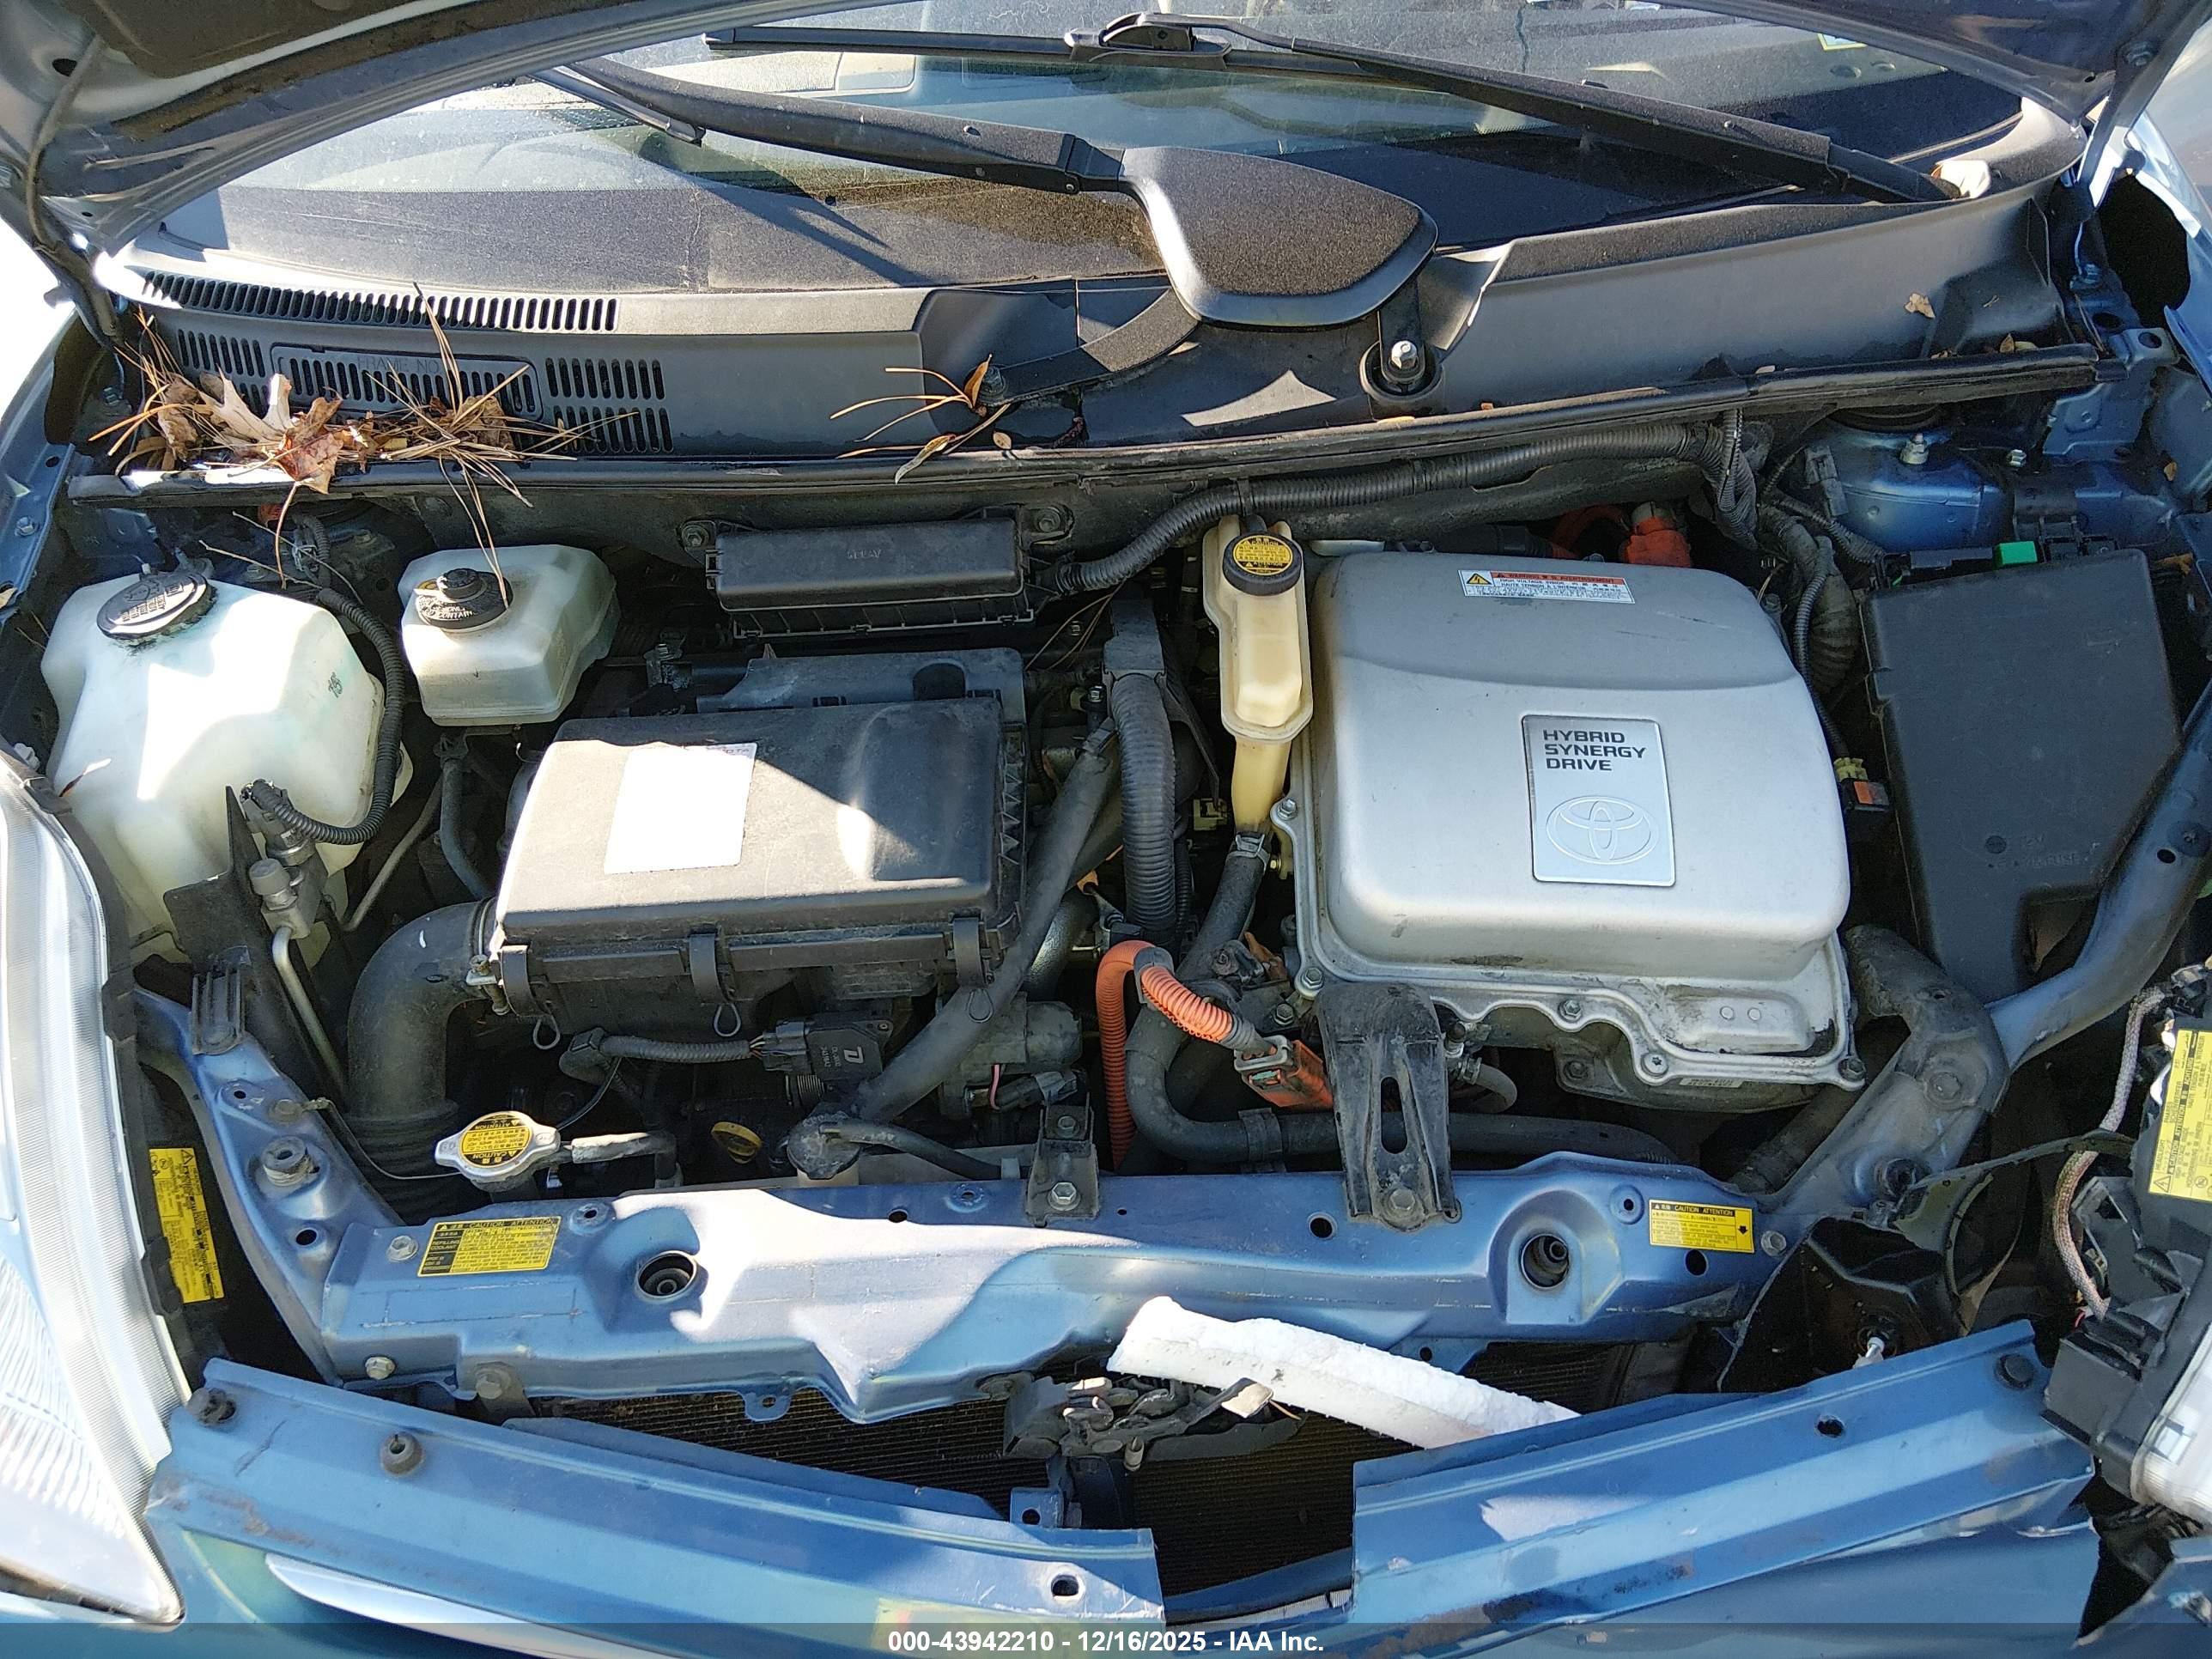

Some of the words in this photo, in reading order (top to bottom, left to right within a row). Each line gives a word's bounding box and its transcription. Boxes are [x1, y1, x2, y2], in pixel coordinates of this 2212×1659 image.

[1542, 729, 1626, 744] HYBRID
[1544, 744, 1647, 758] SYNERGY
[1546, 758, 1613, 771] DRIVE
[2168, 1139, 2179, 1166] CAUTION
[2174, 1104, 2186, 1136] ATTENTION
[2184, 1057, 2195, 1085] ACHTUNG
[471, 1151, 507, 1159] CAUTION
[1674, 1205, 1700, 1213] CAUTION
[1702, 1207, 1734, 1216] ATTENTION
[470, 1220, 505, 1229] CAUTION
[510, 1218, 555, 1226] ATTENTION
